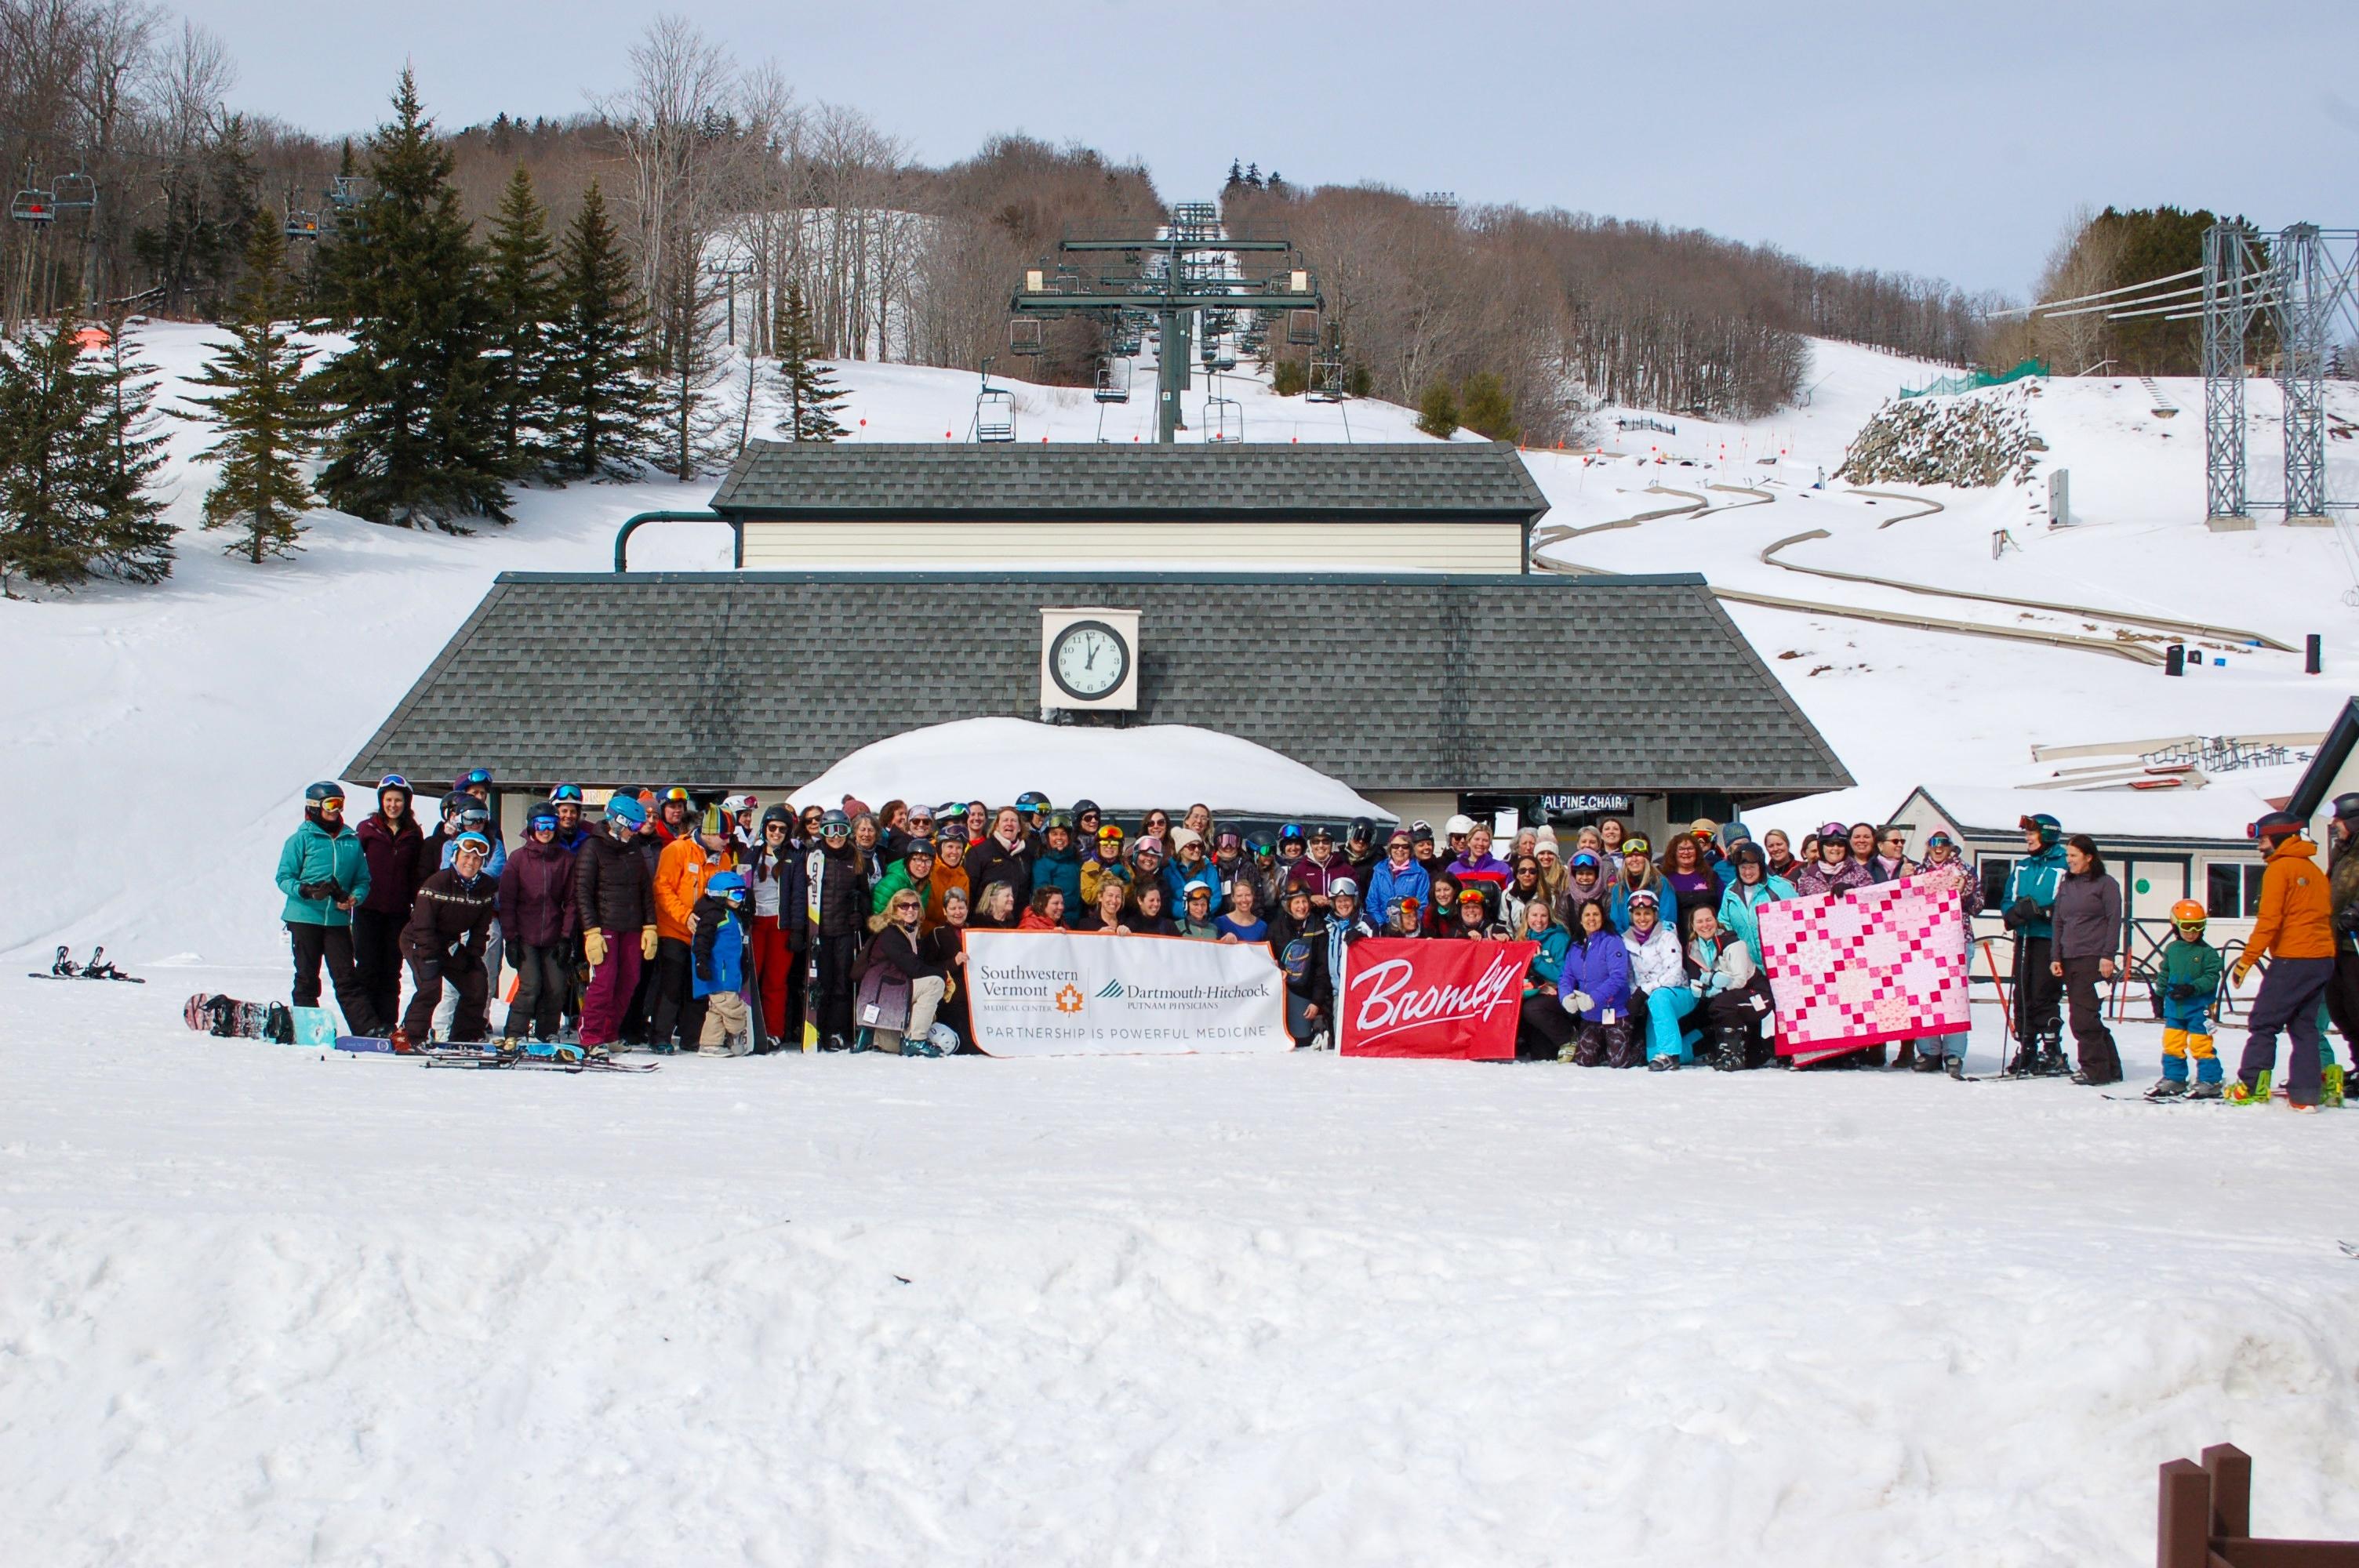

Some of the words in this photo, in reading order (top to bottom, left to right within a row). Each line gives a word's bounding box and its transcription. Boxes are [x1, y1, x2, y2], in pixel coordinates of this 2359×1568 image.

[1544, 796, 1585, 808] ALPINE
[1588, 796, 1622, 808] CHAIR
[981, 965, 1078, 981] Southwestern
[983, 982, 1048, 996] Vermont
[1128, 983, 1270, 999] Dartmouth-Hitchcock
[986, 1026, 1085, 1039] PARTNERSHIP
[1092, 1028, 1103, 1039] IS
[1110, 1028, 1190, 1040] POWERFUL
